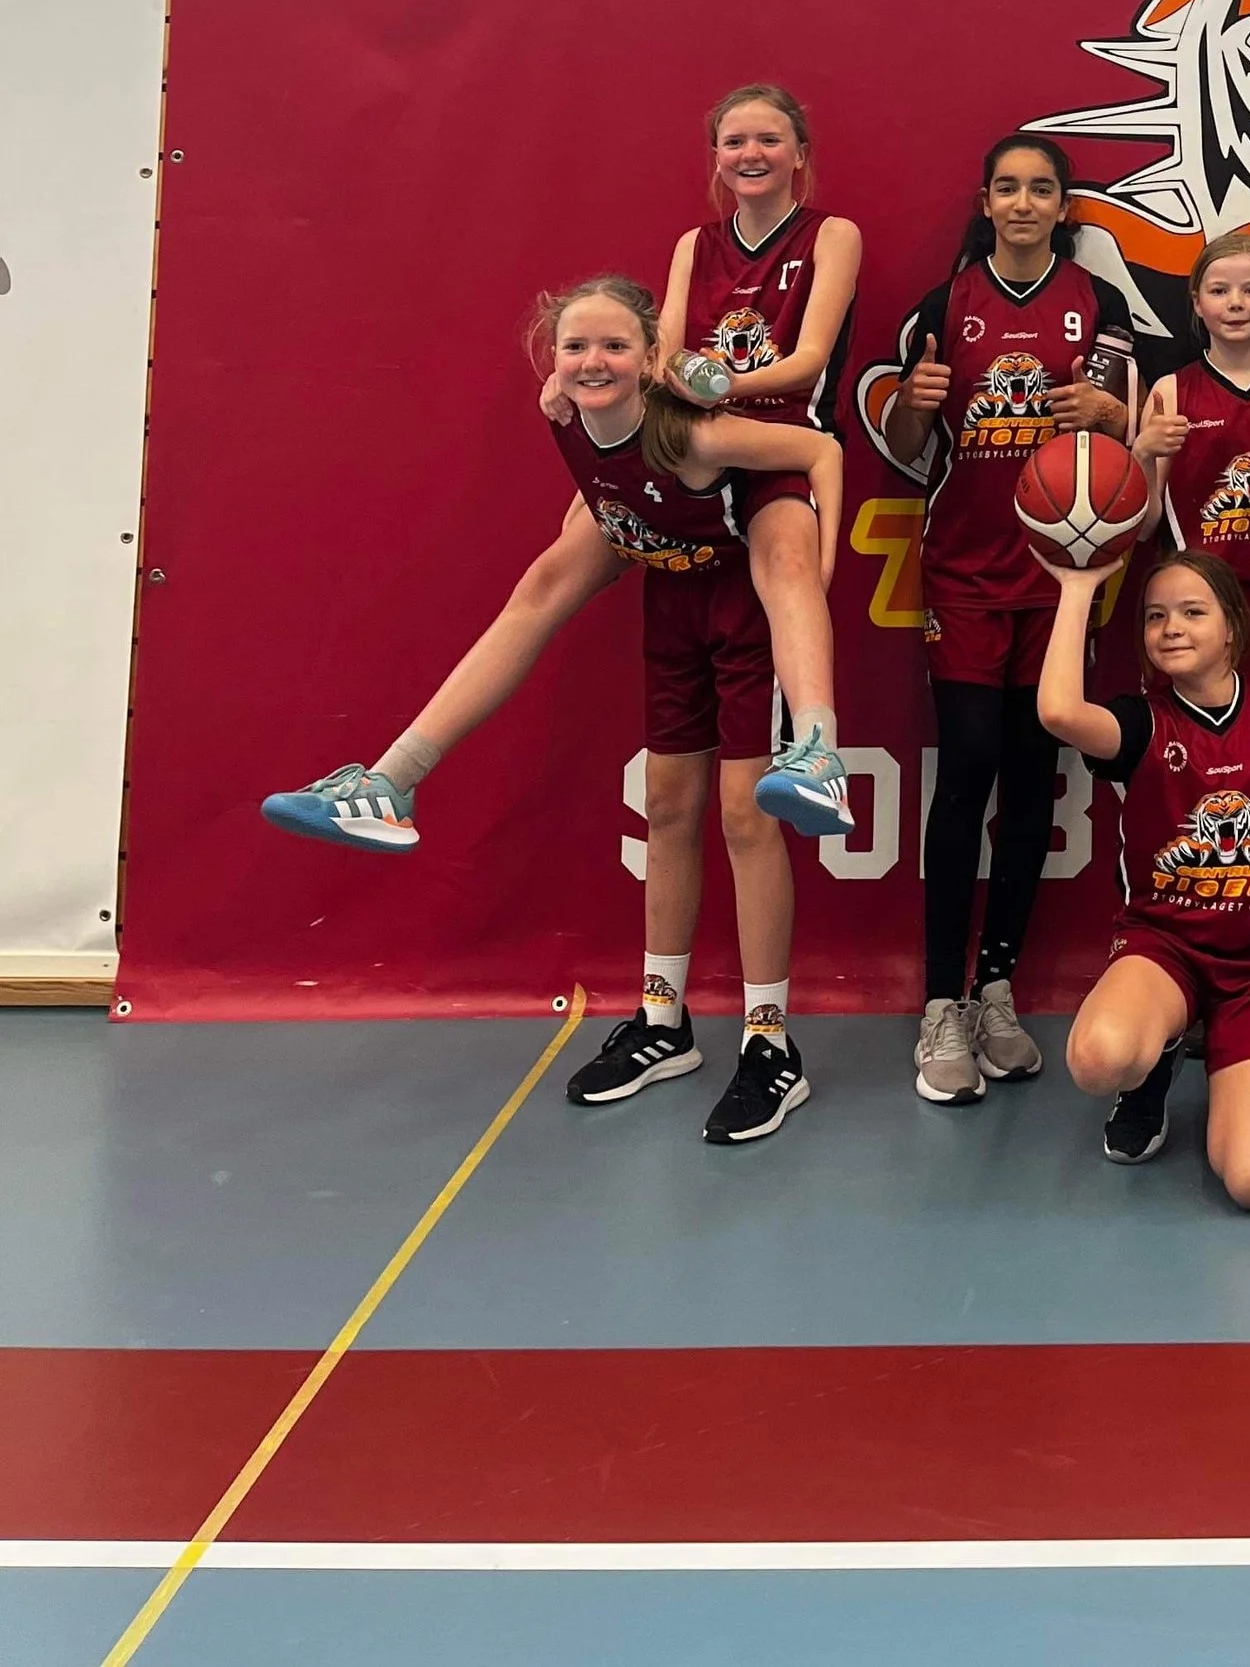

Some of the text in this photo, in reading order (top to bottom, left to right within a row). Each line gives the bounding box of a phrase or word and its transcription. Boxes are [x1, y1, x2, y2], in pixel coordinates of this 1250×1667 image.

[778, 260, 804, 291] 17
[1064, 311, 1082, 342] 9
[959, 428, 1057, 447] TIGER
[643, 481, 663, 503] 4
[1152, 892, 1244, 912] STORBYLAGET
